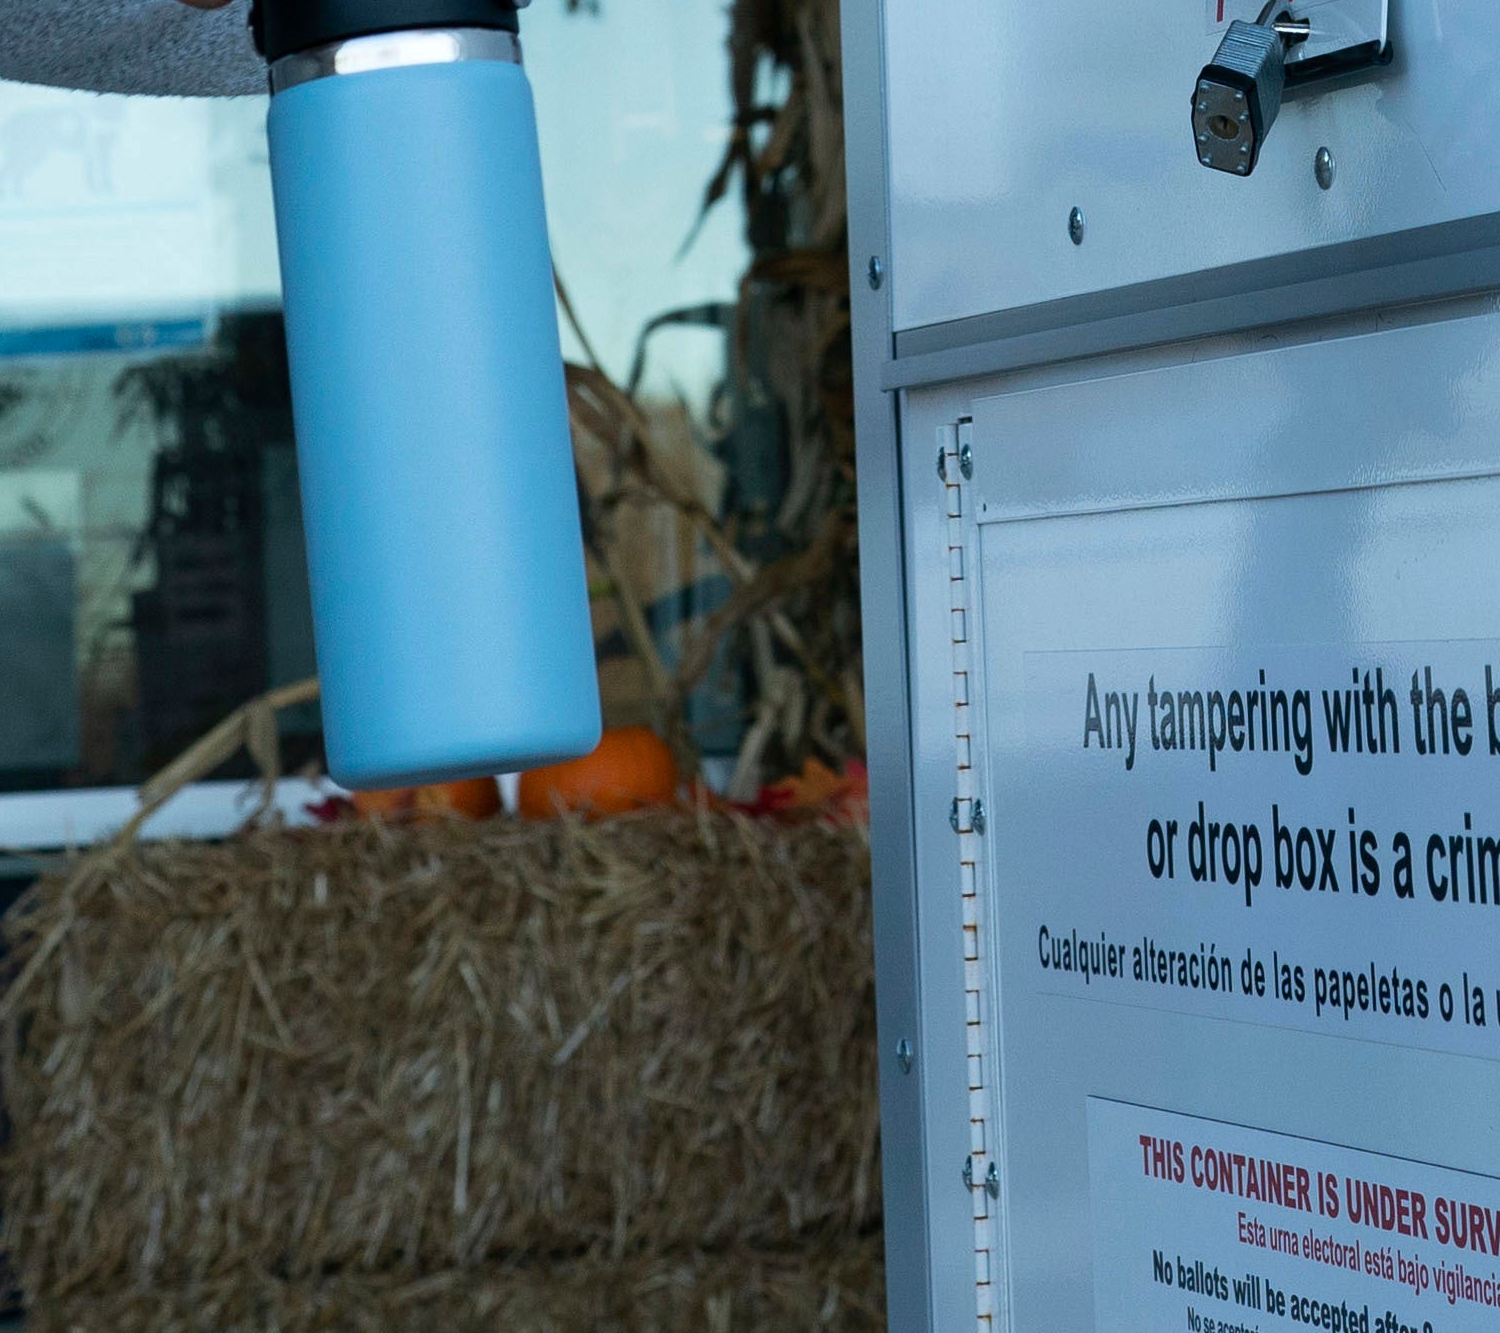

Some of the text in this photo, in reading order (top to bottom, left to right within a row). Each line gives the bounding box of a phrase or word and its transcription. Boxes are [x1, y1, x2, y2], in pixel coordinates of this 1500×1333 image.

[1084, 673, 1138, 771] Any
[1148, 669, 1313, 775] tampering
[1322, 668, 1399, 754] with
[1410, 666, 1472, 756] the
[1147, 819, 1177, 878] or
[1188, 802, 1262, 906] drop
[1272, 805, 1339, 892] box
[1349, 808, 1380, 896] is
[1393, 832, 1414, 898] a
[1039, 925, 1125, 984] Cualquier
[1133, 937, 1232, 992] alteración
[1241, 948, 1265, 997] de
[1274, 951, 1305, 1002] las
[1315, 962, 1429, 1020] papeletas
[1440, 983, 1453, 1022] o
[1463, 973, 1486, 1026] la
[1140, 1135, 1184, 1183] THIS
[1191, 1146, 1312, 1212] CONTAINER
[1318, 1172, 1339, 1218] IS
[1346, 1178, 1428, 1240] UNDER
[1153, 1250, 1417, 1333] No ballots will be accepted aft
[1238, 1212, 1266, 1247] Esta
[1270, 1228, 1299, 1256] urna
[1303, 1239, 1360, 1271] electoral
[1365, 1247, 1394, 1280] está
[1398, 1250, 1429, 1295] bajo
[1188, 1306, 1201, 1333] No
